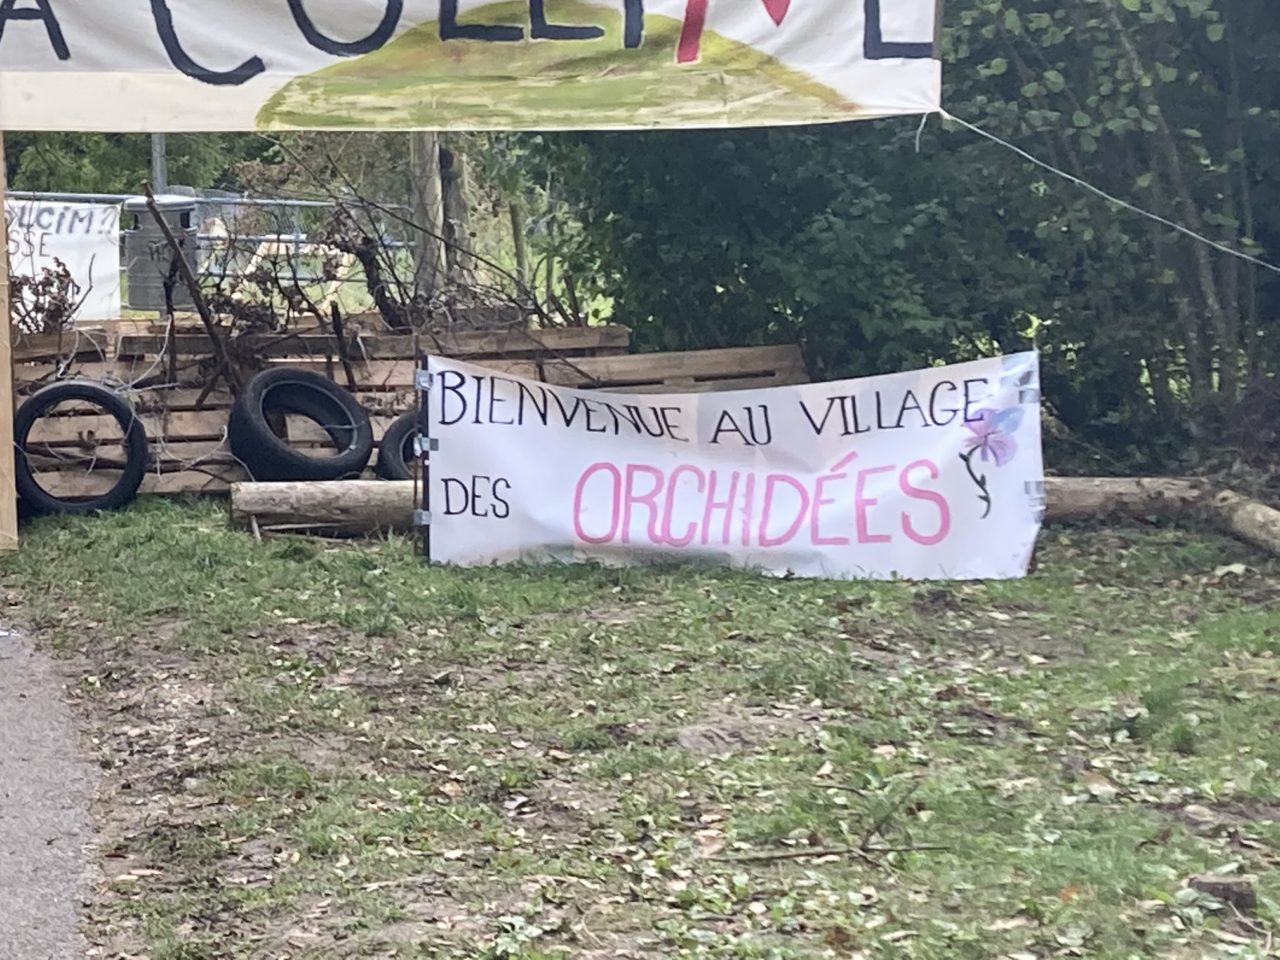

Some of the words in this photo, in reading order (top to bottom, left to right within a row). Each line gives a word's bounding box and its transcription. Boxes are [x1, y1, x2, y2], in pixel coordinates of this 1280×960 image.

[437, 369, 689, 443] BIENVENUE
[711, 404, 773, 446] AU
[800, 378, 989, 438] VILLAGE
[441, 476, 512, 519] DES
[573, 451, 951, 549] ORCHIDÉES
